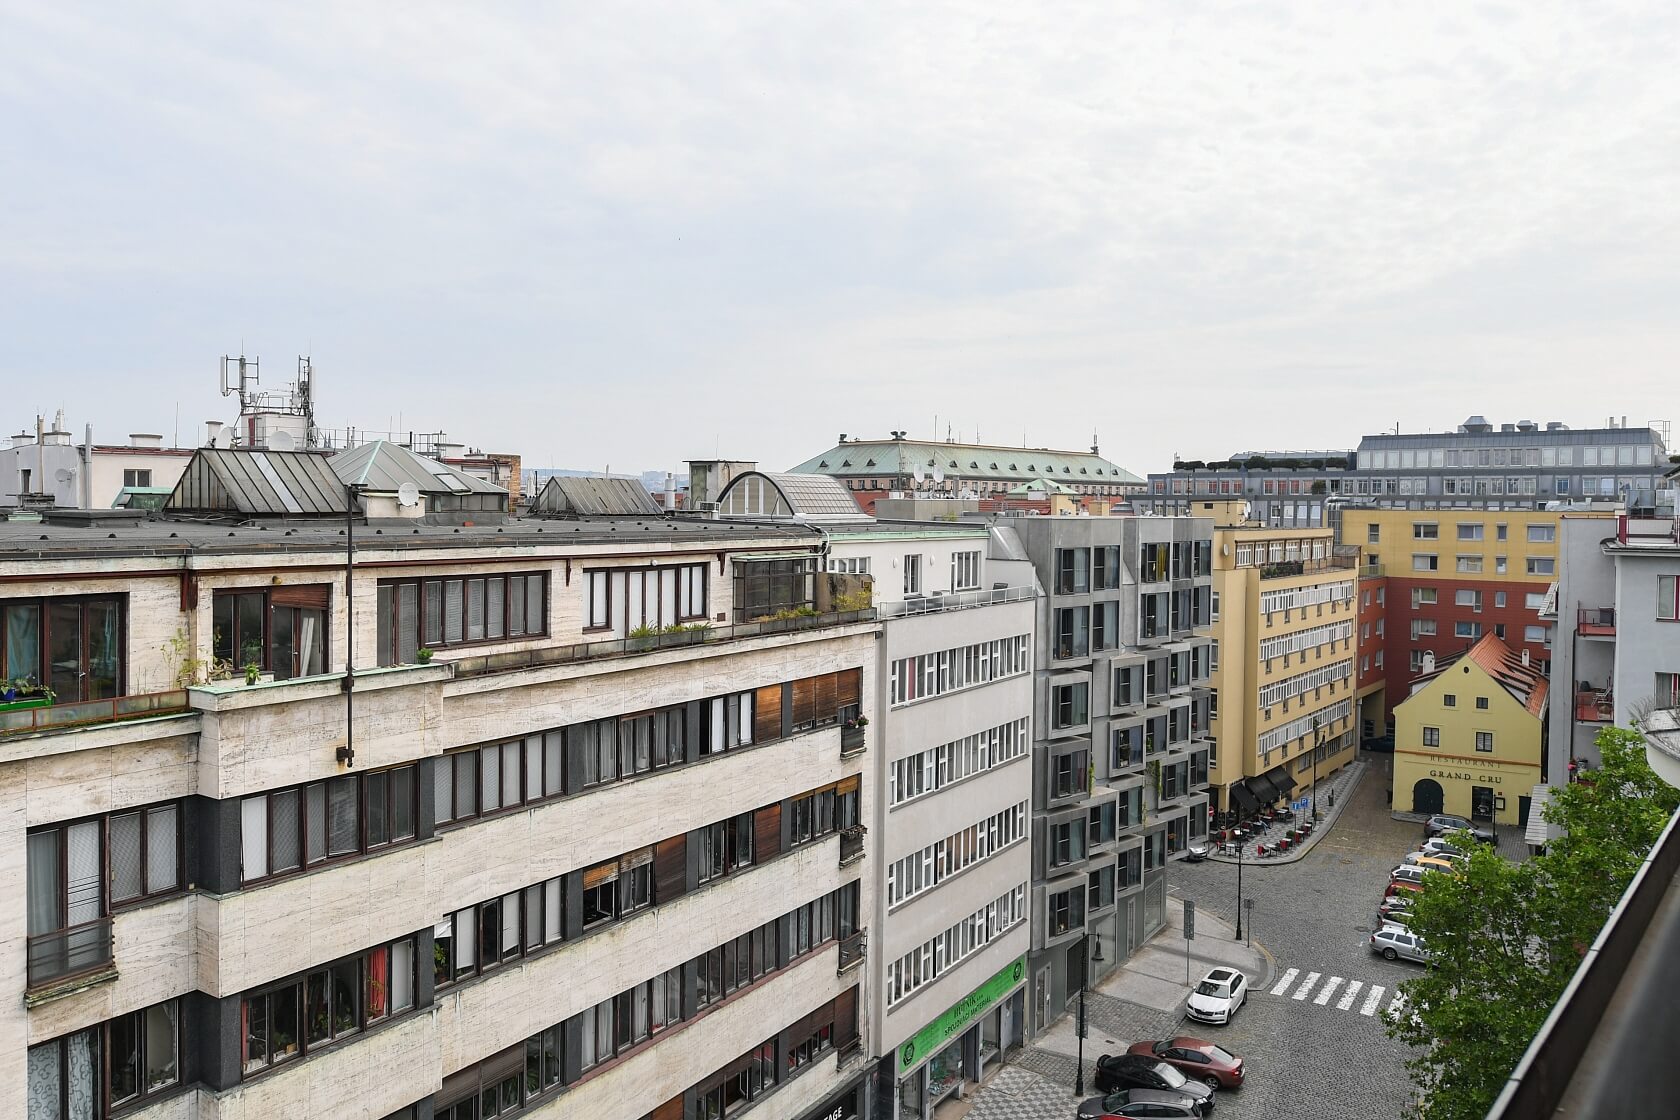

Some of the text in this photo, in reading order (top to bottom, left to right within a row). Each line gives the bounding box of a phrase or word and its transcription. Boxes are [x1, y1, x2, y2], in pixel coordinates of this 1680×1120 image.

[1430, 755, 1501, 768] RESTAURANT
[1429, 769, 1502, 784] GRAND CRU
